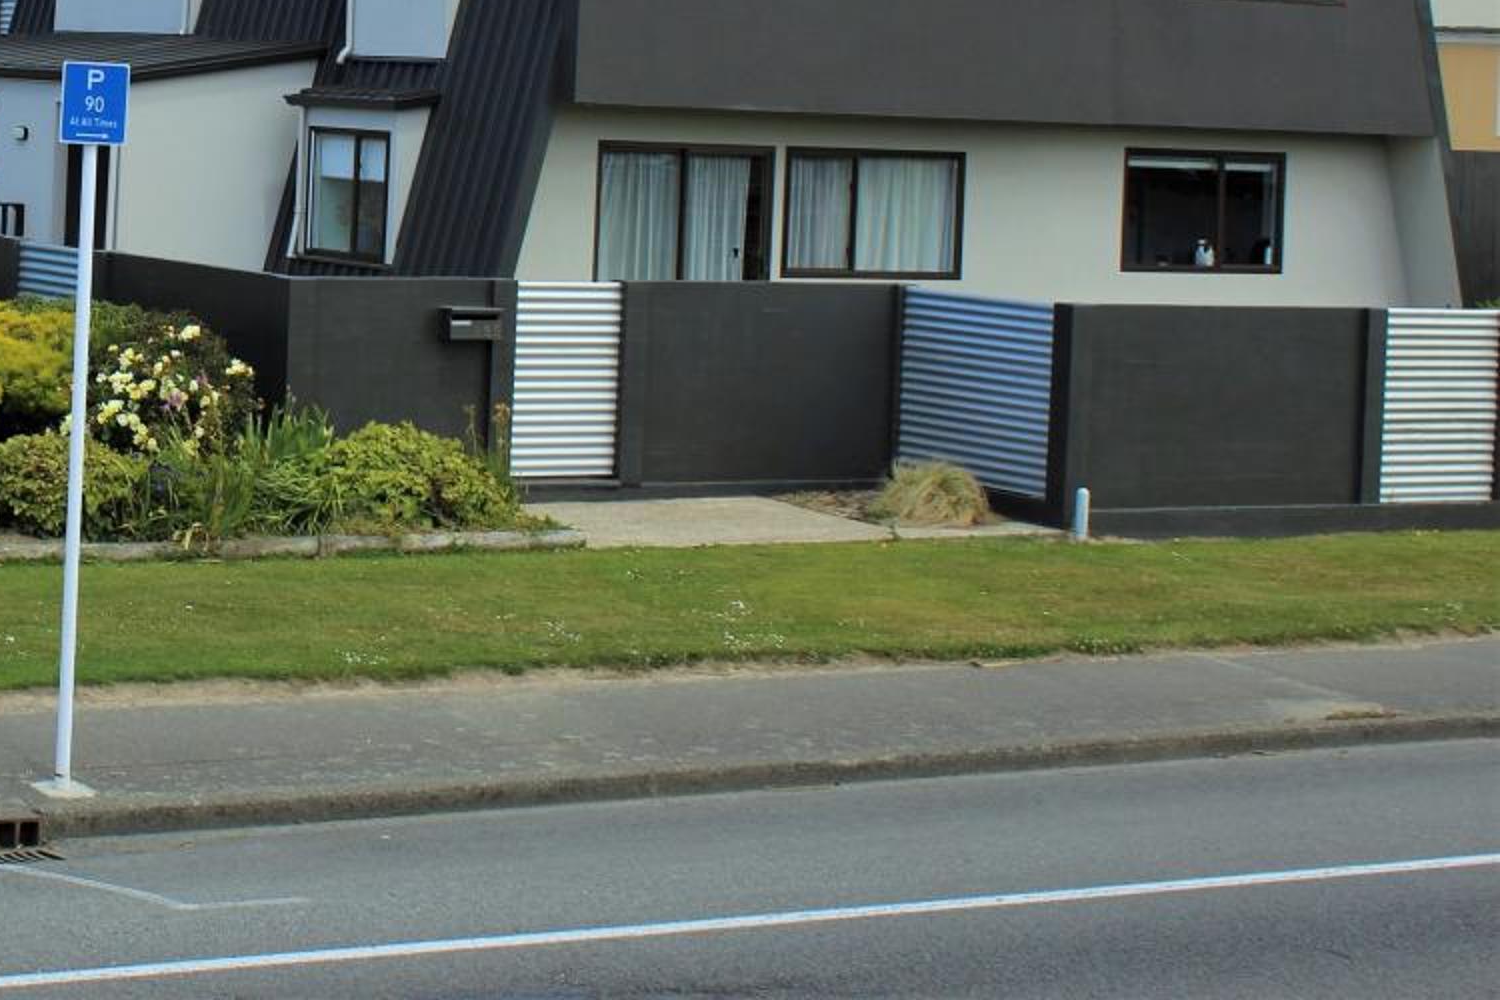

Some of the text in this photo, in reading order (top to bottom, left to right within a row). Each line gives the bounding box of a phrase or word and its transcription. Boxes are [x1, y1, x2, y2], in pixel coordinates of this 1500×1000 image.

[87, 69, 105, 91] P
[85, 95, 105, 113] 90
[69, 116, 117, 129] At All Times
